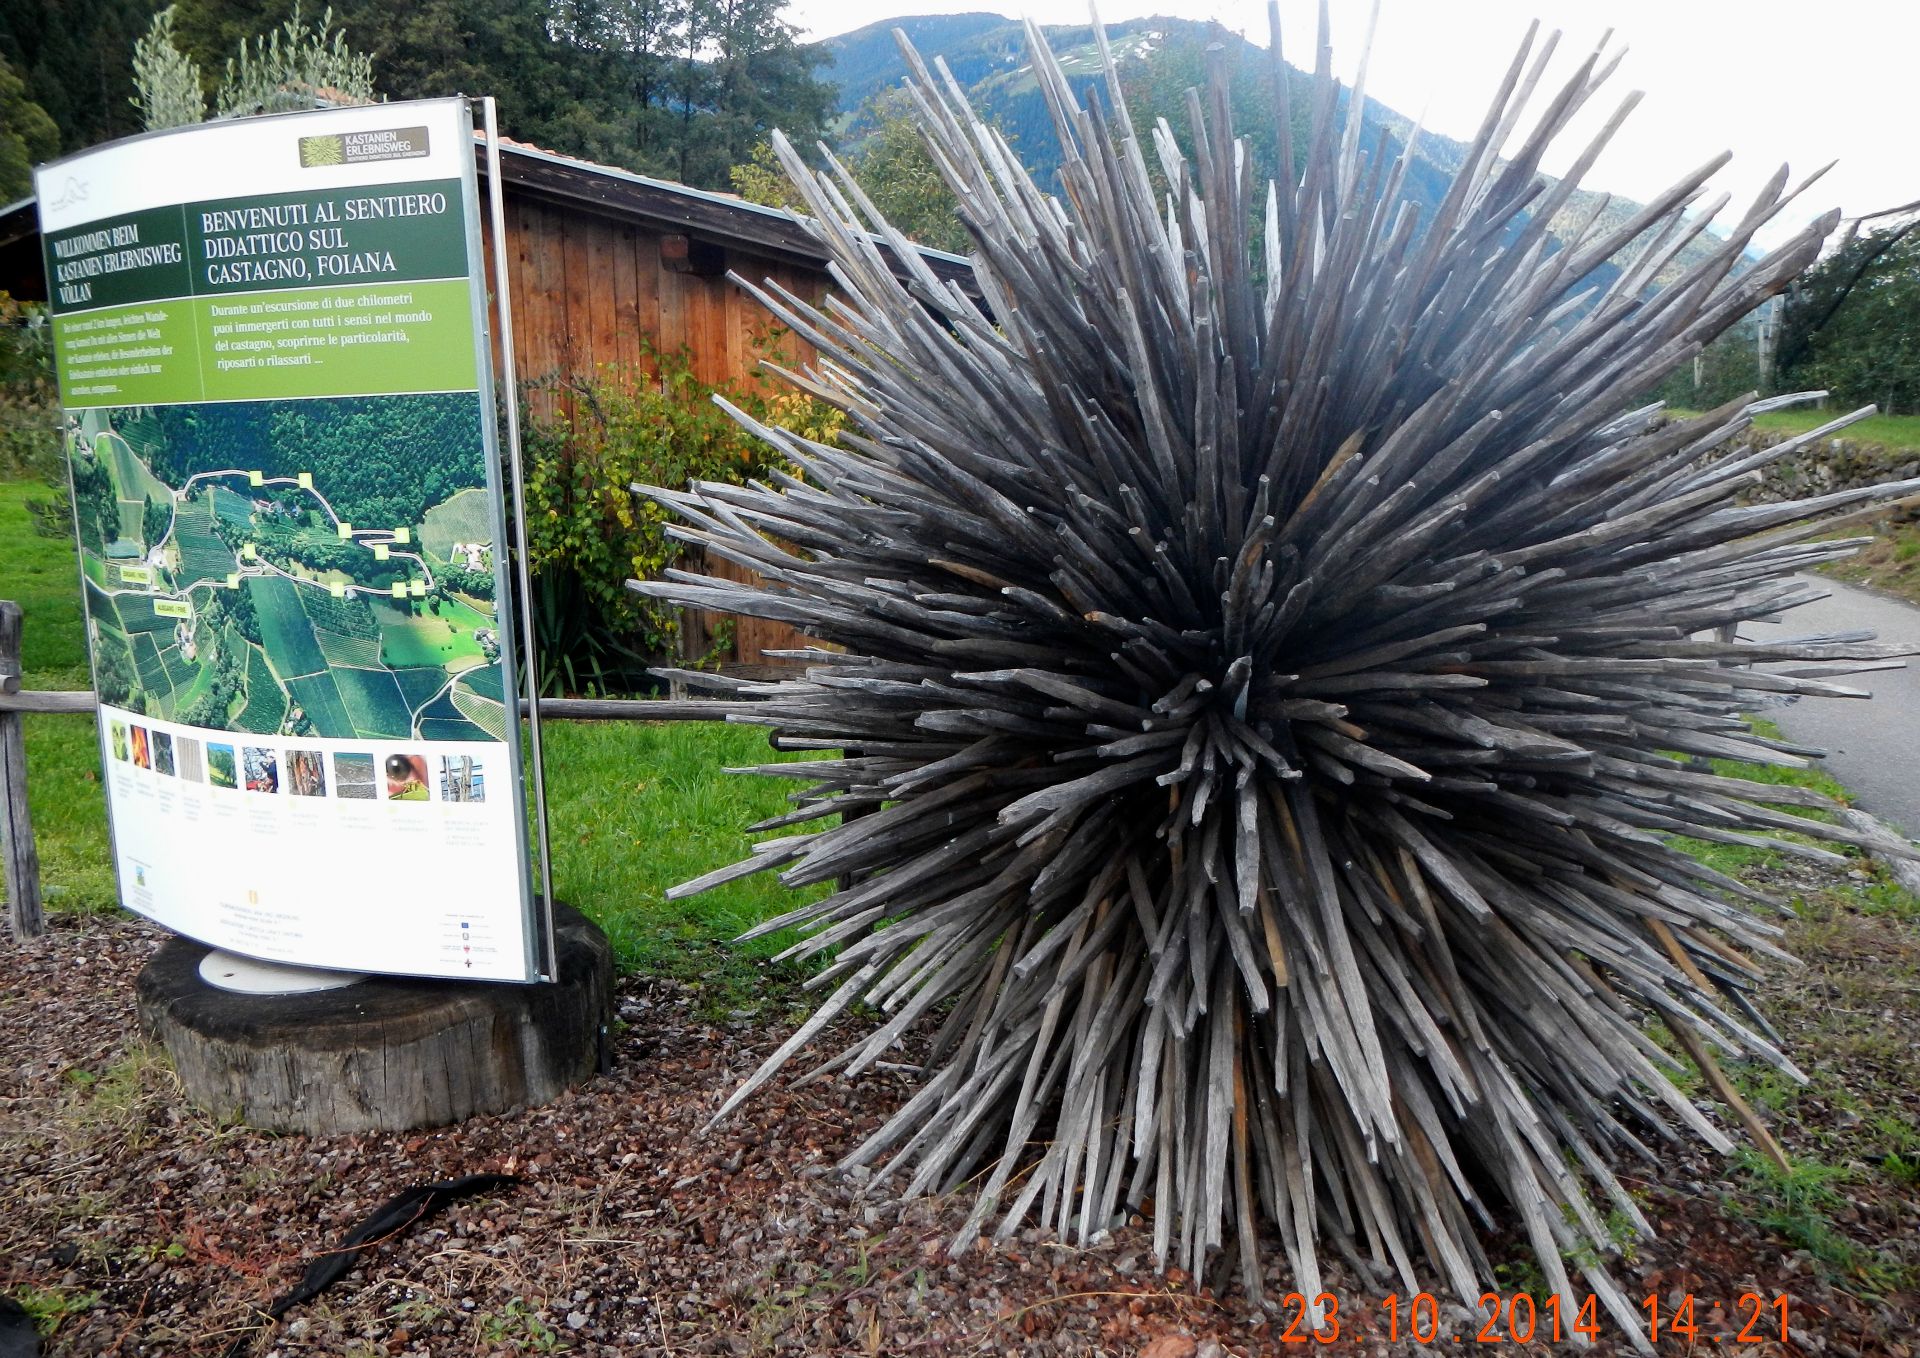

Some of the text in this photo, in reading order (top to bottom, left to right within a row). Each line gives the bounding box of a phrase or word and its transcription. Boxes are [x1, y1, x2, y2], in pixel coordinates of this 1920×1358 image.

[345, 131, 397, 146] KASTANIEN
[346, 141, 411, 156] ERLEBNISWEG
[202, 192, 447, 234] BENVENUTI AL SENTIERO
[54, 224, 140, 259] WILLKOMMEN BEIM
[204, 227, 349, 260] DIDATTICO SUL
[56, 243, 182, 282] KASTANIEN ERLEBNISWEG
[207, 251, 397, 285] CASTAGNO, FOIANA
[59, 282, 92, 305] VÖLLAN
[211, 303, 248, 316] Durante
[322, 297, 333, 310] di
[335, 296, 354, 308] due
[357, 292, 413, 306] chilometri
[213, 309, 433, 336] puoi immergerti con tutti i sensi nel mondo
[215, 329, 410, 352] del castagno, scoprirne le particolarità,
[217, 355, 256, 371] riposarti
[258, 358, 265, 367] o
[266, 352, 311, 366] rilassarti
